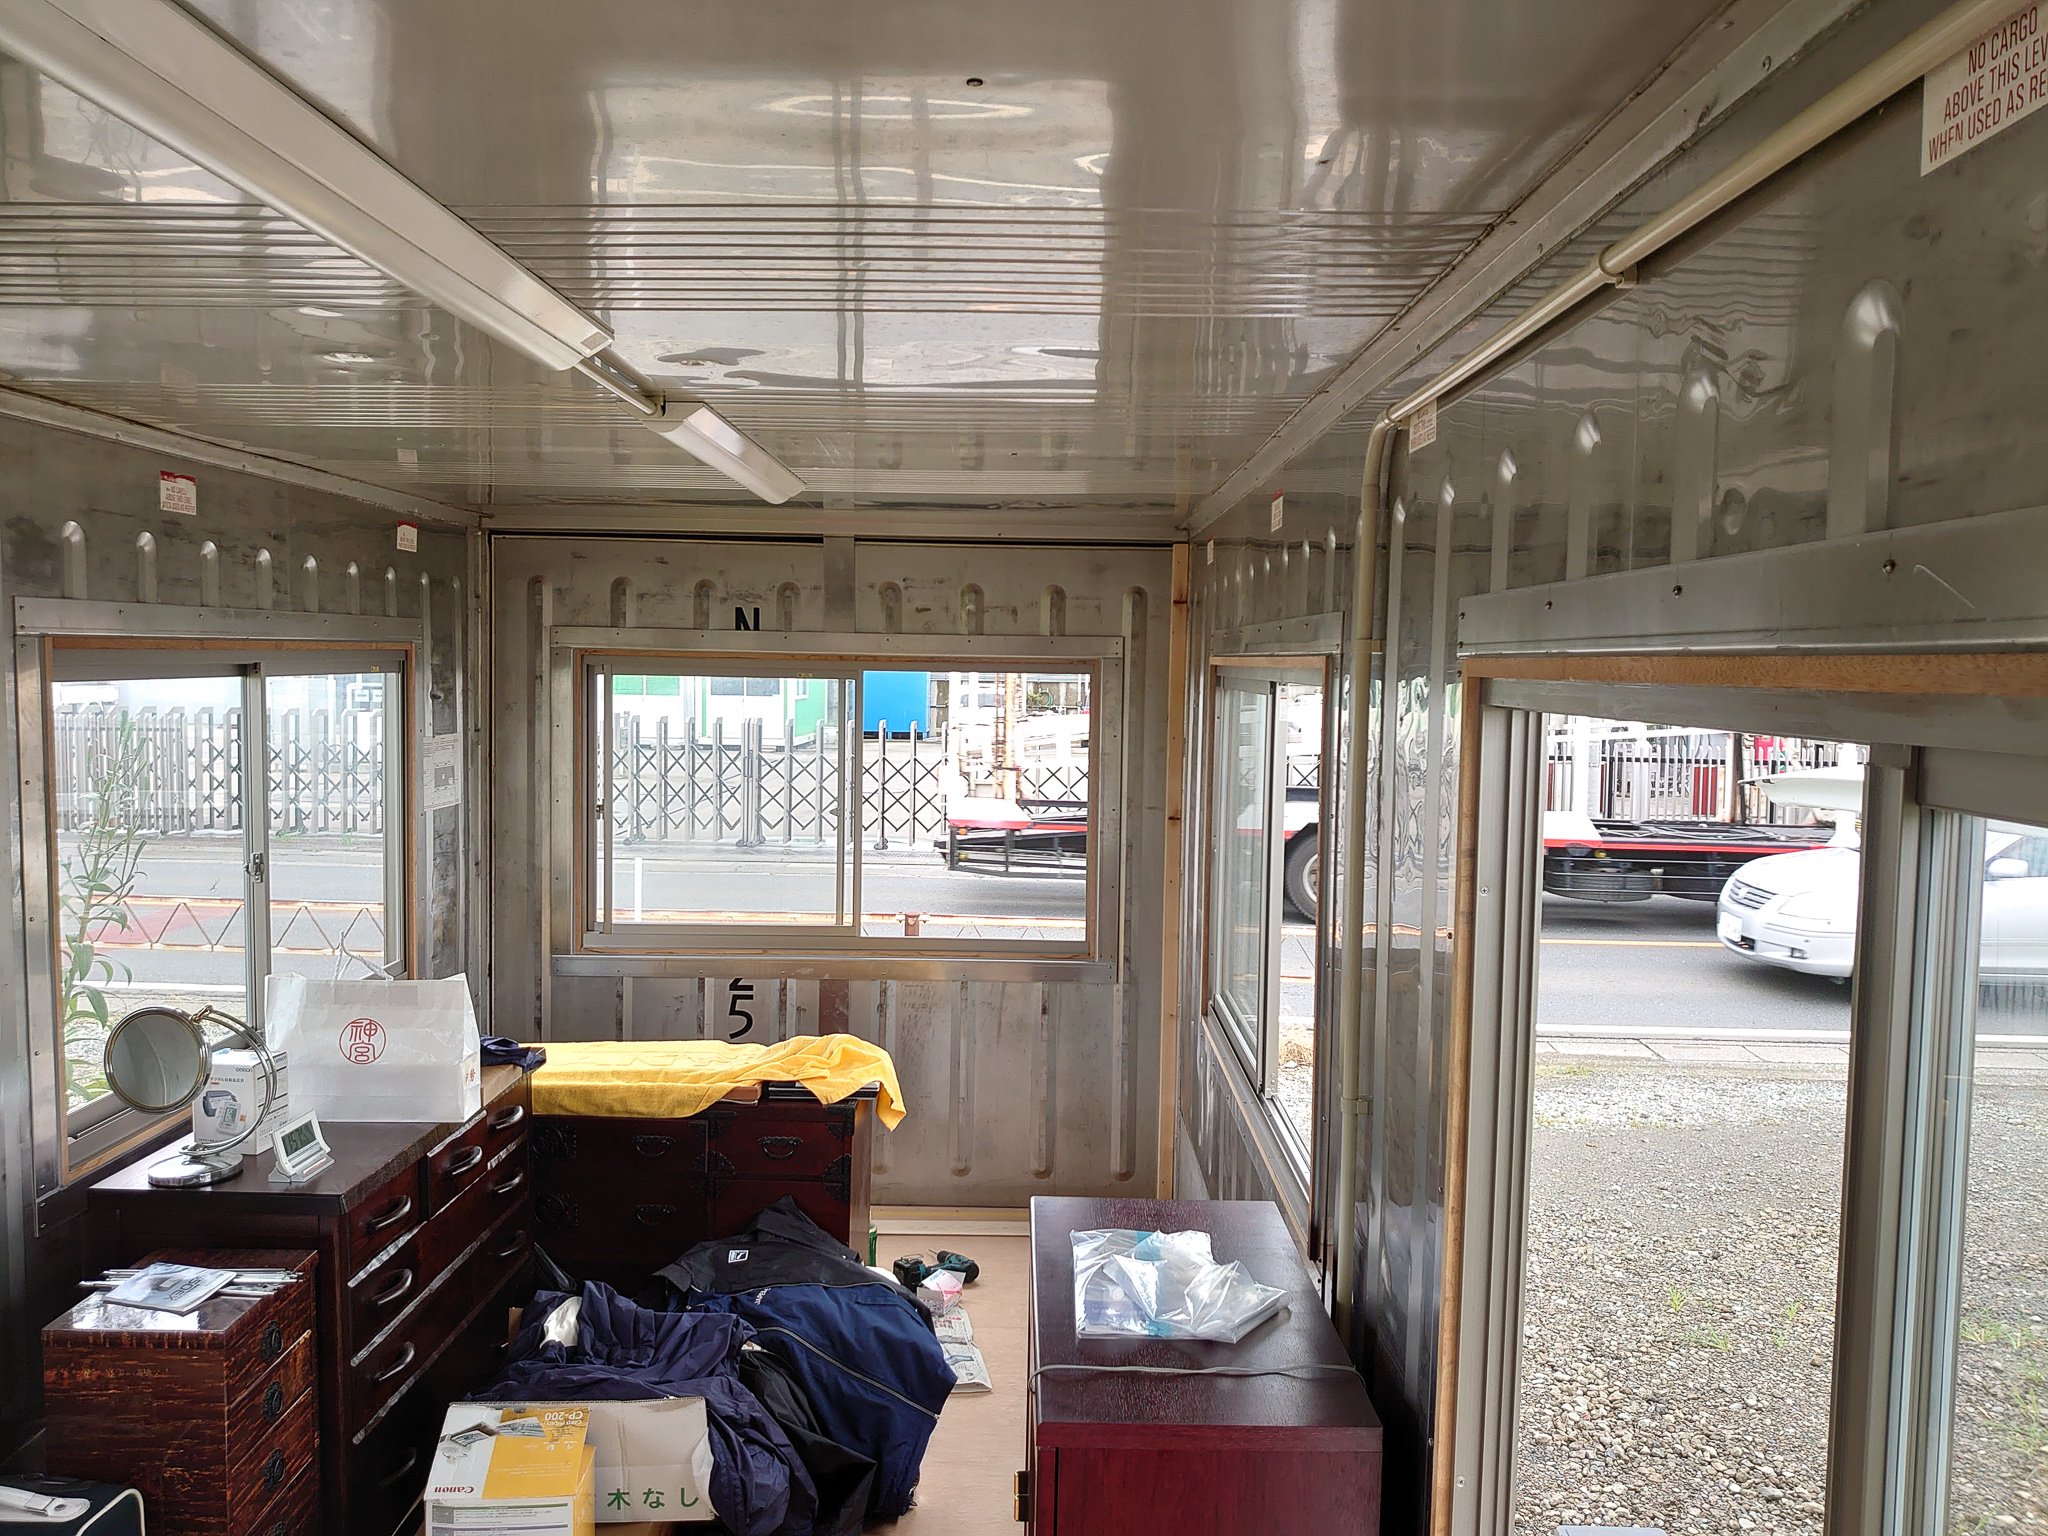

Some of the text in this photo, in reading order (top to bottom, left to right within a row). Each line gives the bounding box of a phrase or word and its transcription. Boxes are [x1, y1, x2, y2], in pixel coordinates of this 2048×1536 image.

[1968, 6, 2038, 76] NO CARGO
[1943, 74, 1985, 124] ABOVE
[1989, 51, 2020, 94] THIS
[1928, 120, 1964, 163] WHEN
[1967, 97, 2002, 140] USED
[2006, 82, 2025, 118] AS
[544, 1411, 583, 1421] CP-200
[434, 1485, 475, 1494] Canon
[606, 1487, 700, 1511] 木なし
